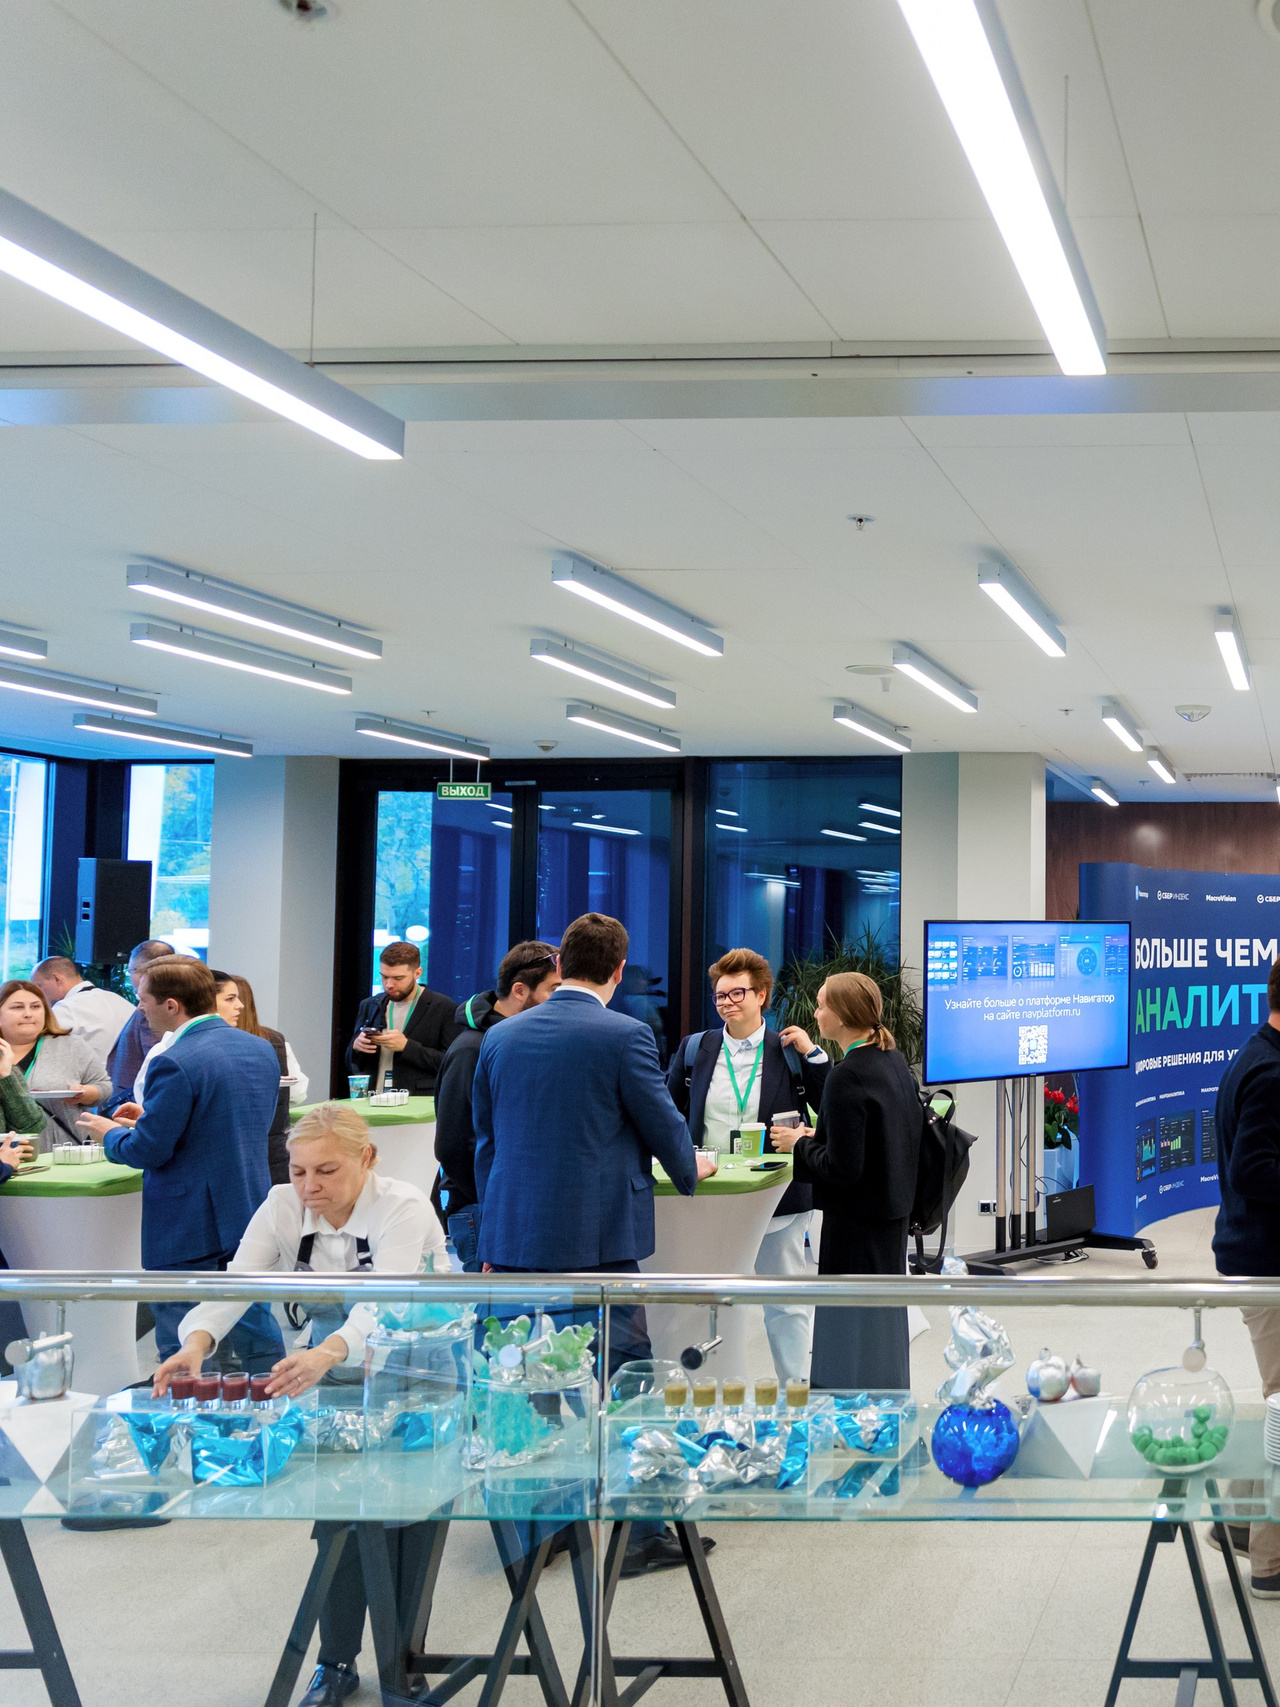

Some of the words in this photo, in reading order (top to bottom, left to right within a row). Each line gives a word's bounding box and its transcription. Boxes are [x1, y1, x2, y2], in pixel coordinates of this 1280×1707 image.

[441, 786, 485, 797] ВЫХОД
[1205, 894, 1237, 902] MacroVision
[1135, 938, 1208, 969] БОЛЬШЕ
[1215, 938, 1278, 967] ЧЕМ
[944, 998, 982, 1010] Узнайте
[983, 996, 1017, 1008] больше
[1018, 999, 1024, 1007] о
[1025, 994, 1071, 1007] платформе
[1072, 993, 1115, 1005] Навигатор
[983, 1012, 995, 1021] на
[996, 1010, 1021, 1021] сайте
[1022, 1007, 1081, 1020] navplatform.ru
[1135, 984, 1268, 1035] АНАЛИТ
[1162, 1051, 1202, 1068] РЕШЕНИЯ
[1203, 1049, 1225, 1065] ДЛЯ
[1200, 1174, 1219, 1183] MacroVi
